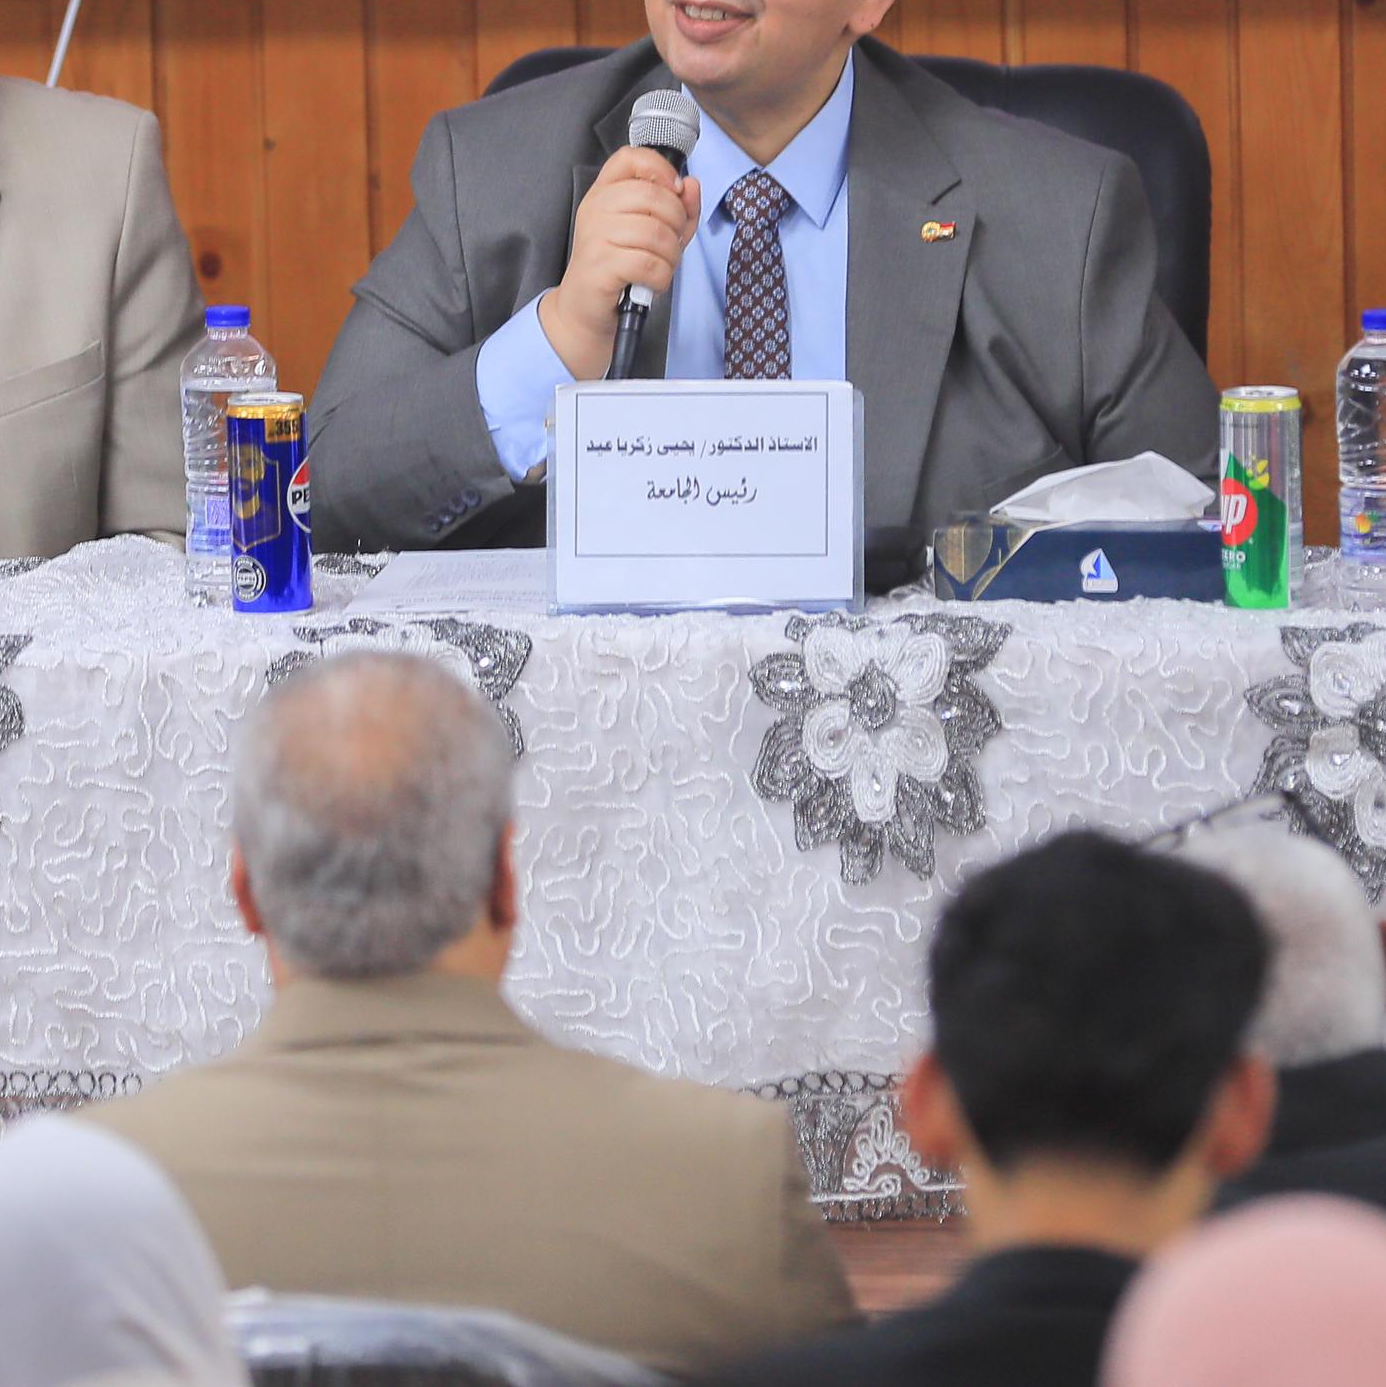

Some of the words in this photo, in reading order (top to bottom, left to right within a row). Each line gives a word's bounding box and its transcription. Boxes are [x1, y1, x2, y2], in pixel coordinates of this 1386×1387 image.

[616, 435, 652, 456] زكريا
[656, 439, 695, 456] يحيى
[646, 475, 700, 504] الجامعة
[706, 477, 758, 506] رئيس
